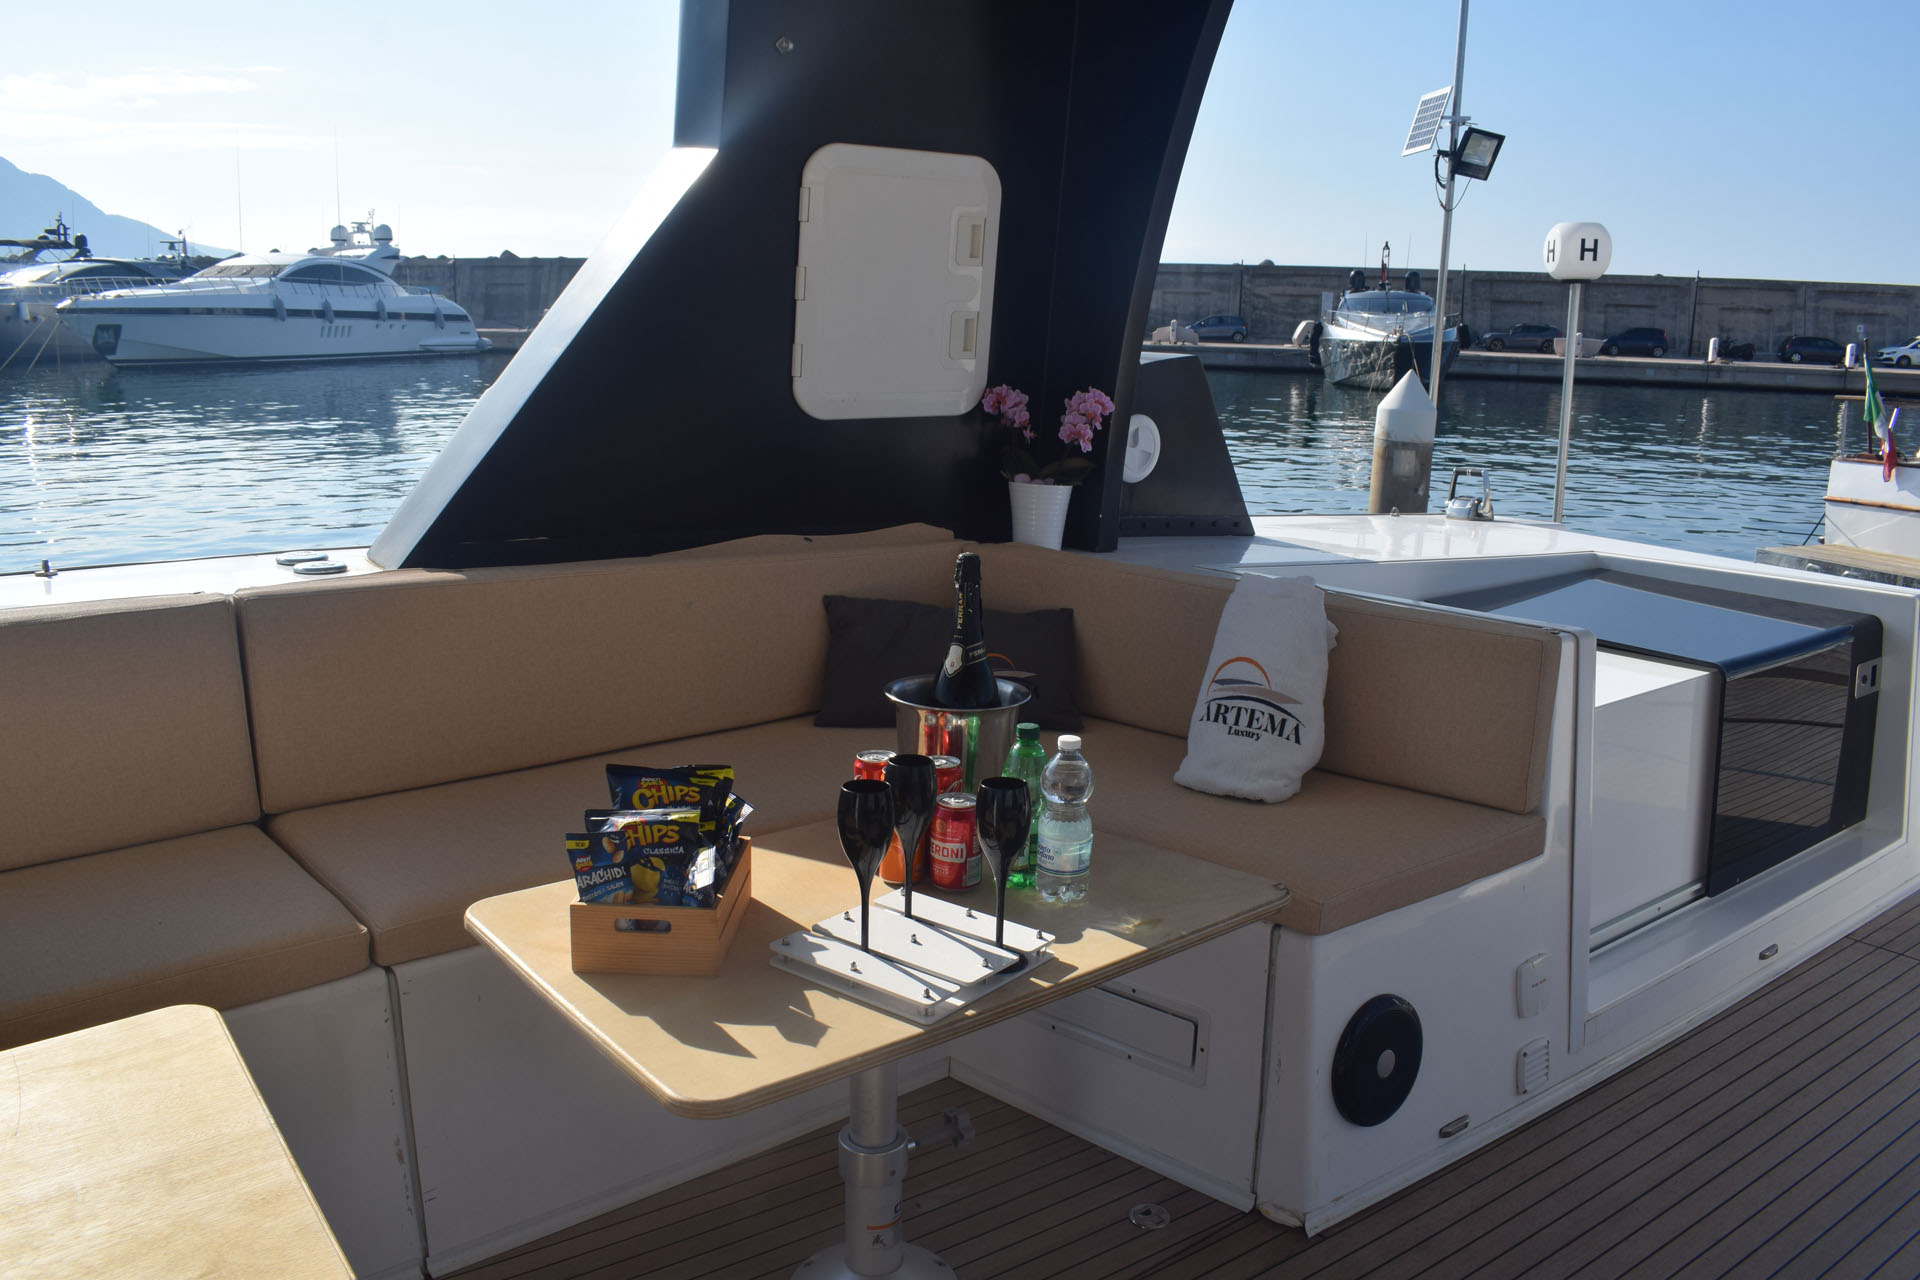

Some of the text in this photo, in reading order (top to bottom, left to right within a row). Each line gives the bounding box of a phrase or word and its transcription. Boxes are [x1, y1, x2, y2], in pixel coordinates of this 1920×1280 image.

[1547, 239, 1556, 263] H
[1580, 238, 1599, 261] H
[1198, 702, 1302, 746] ARTEMA
[1227, 725, 1262, 742] Luxury
[632, 784, 701, 811] CHIPS
[931, 841, 964, 859] ERONI
[576, 865, 627, 889] ARACHIDI
